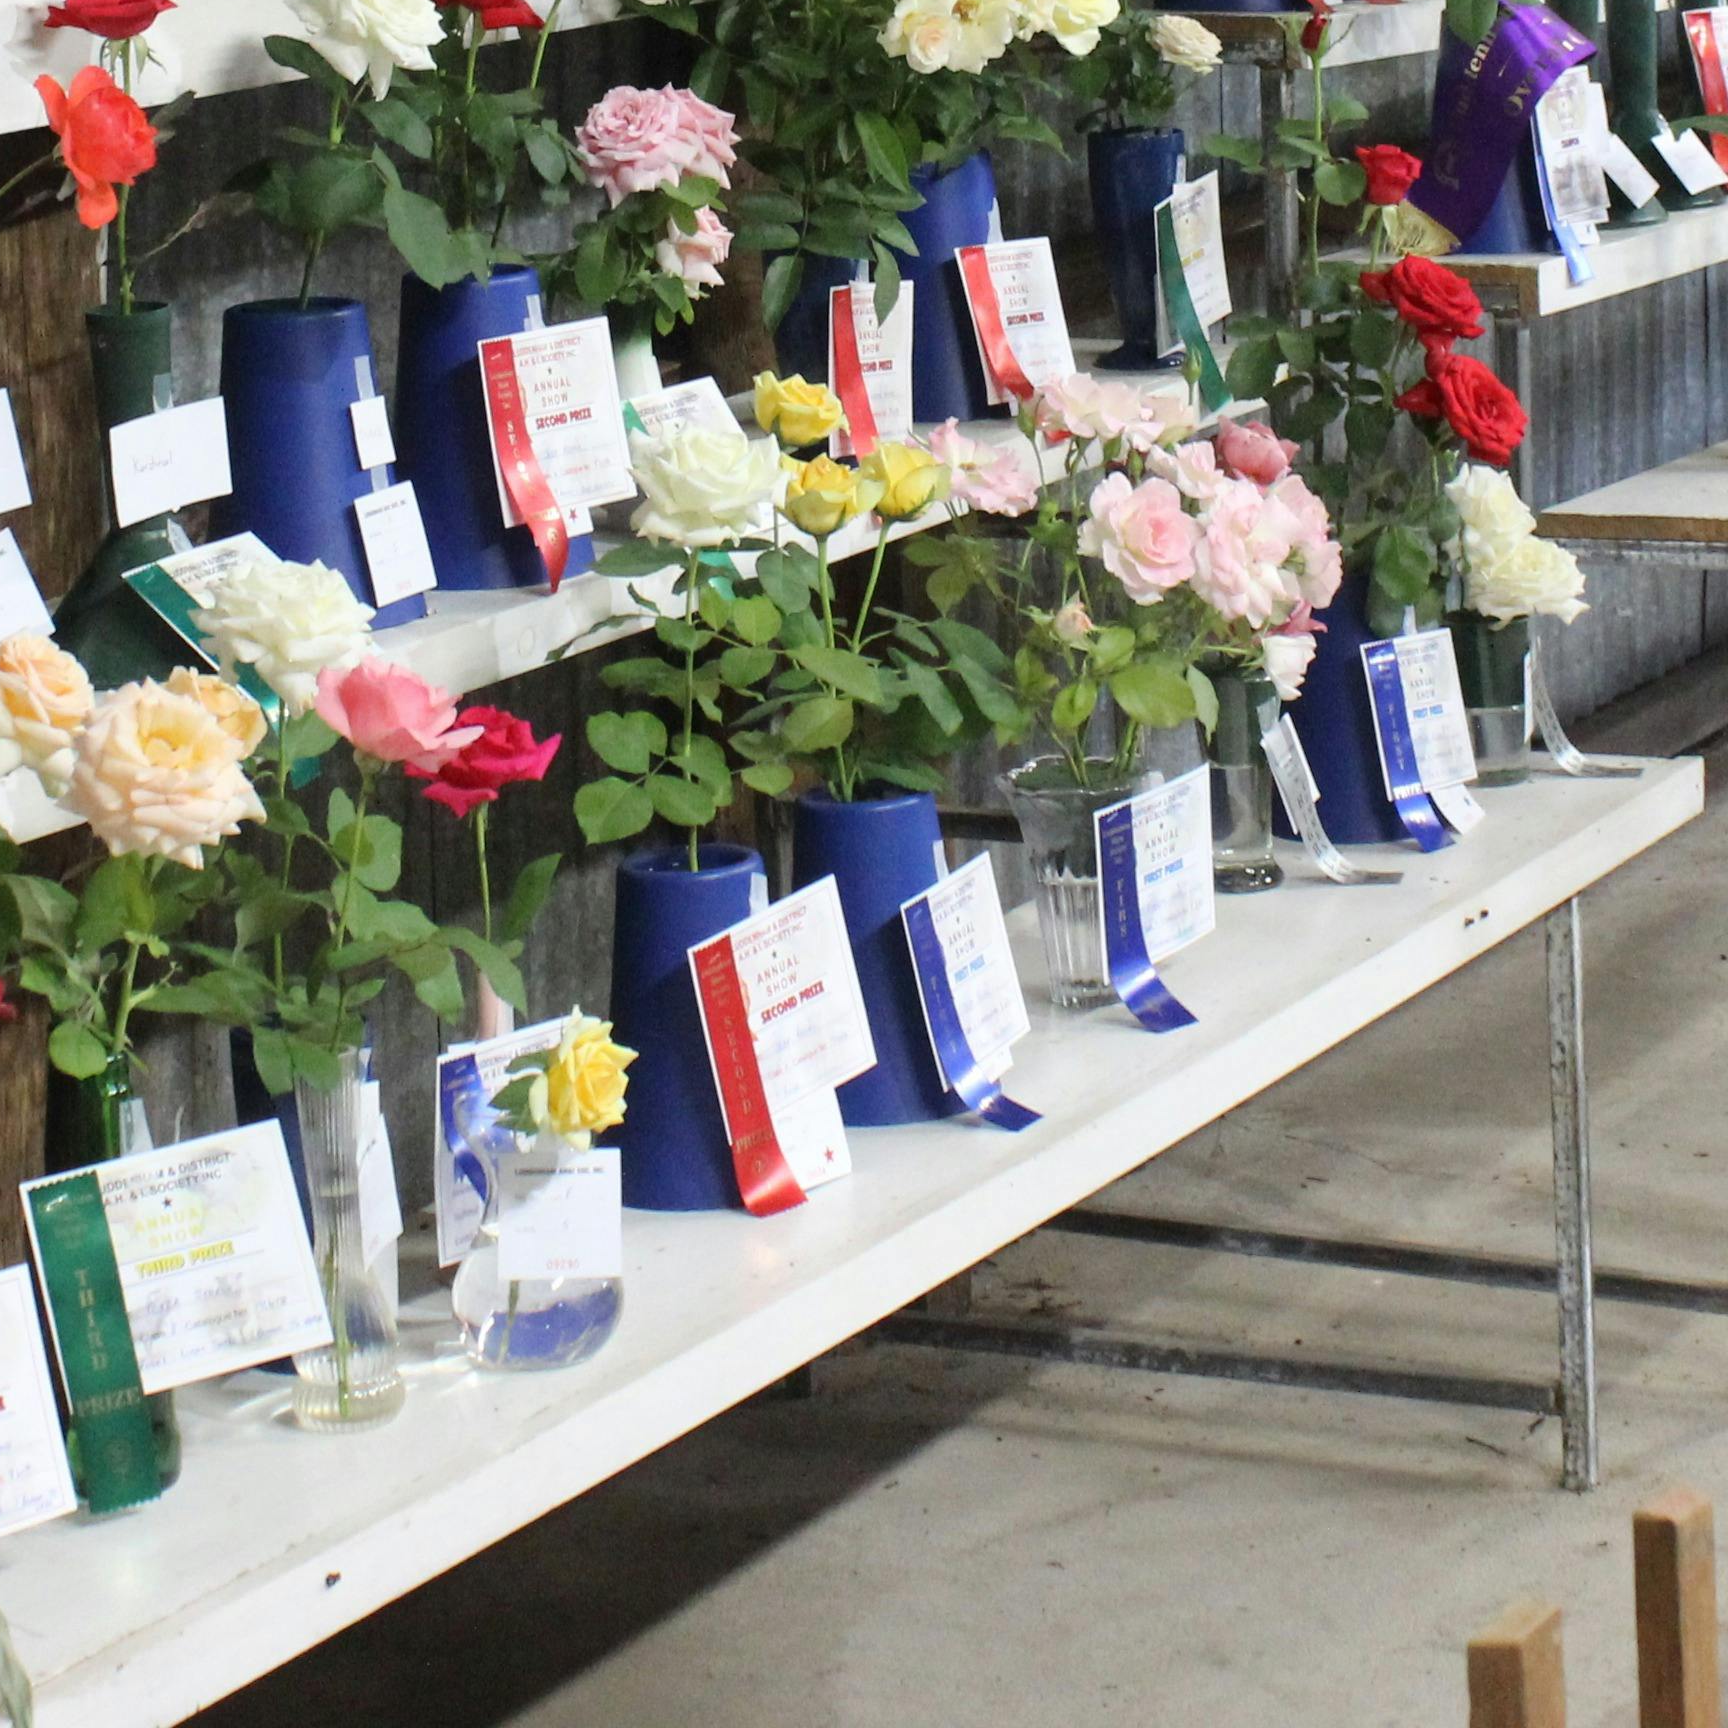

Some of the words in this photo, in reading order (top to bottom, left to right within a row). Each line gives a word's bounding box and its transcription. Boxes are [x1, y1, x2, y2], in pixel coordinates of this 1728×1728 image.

[1005, 313, 1029, 326] SECOND
[534, 376, 571, 394] ANNUAL
[542, 391, 569, 408] SHOW
[535, 413, 568, 430] SECOND
[569, 407, 593, 422] PRIZE
[1145, 828, 1179, 850] ANNUAL
[1151, 843, 1176, 863] SHOW
[1144, 867, 1163, 886] FIRST
[1164, 857, 1183, 878] PRIZE
[779, 906, 808, 931] DISTRICT
[756, 953, 801, 985] ANNUAL
[954, 965, 969, 983] FIRST
[969, 954, 985, 975] PRIZE
[767, 974, 798, 998] SHOW
[760, 995, 798, 1025] SECOND
[798, 980, 825, 1007] PRIZE
[178, 1152, 231, 1178] DISTRICT
[150, 1174, 200, 1198] SOCIETY
[148, 1225, 203, 1250] SHOW
[137, 1253, 186, 1280] THIRD
[187, 1239, 235, 1267] PRIZE
[74, 1268, 108, 1371] THIRD
